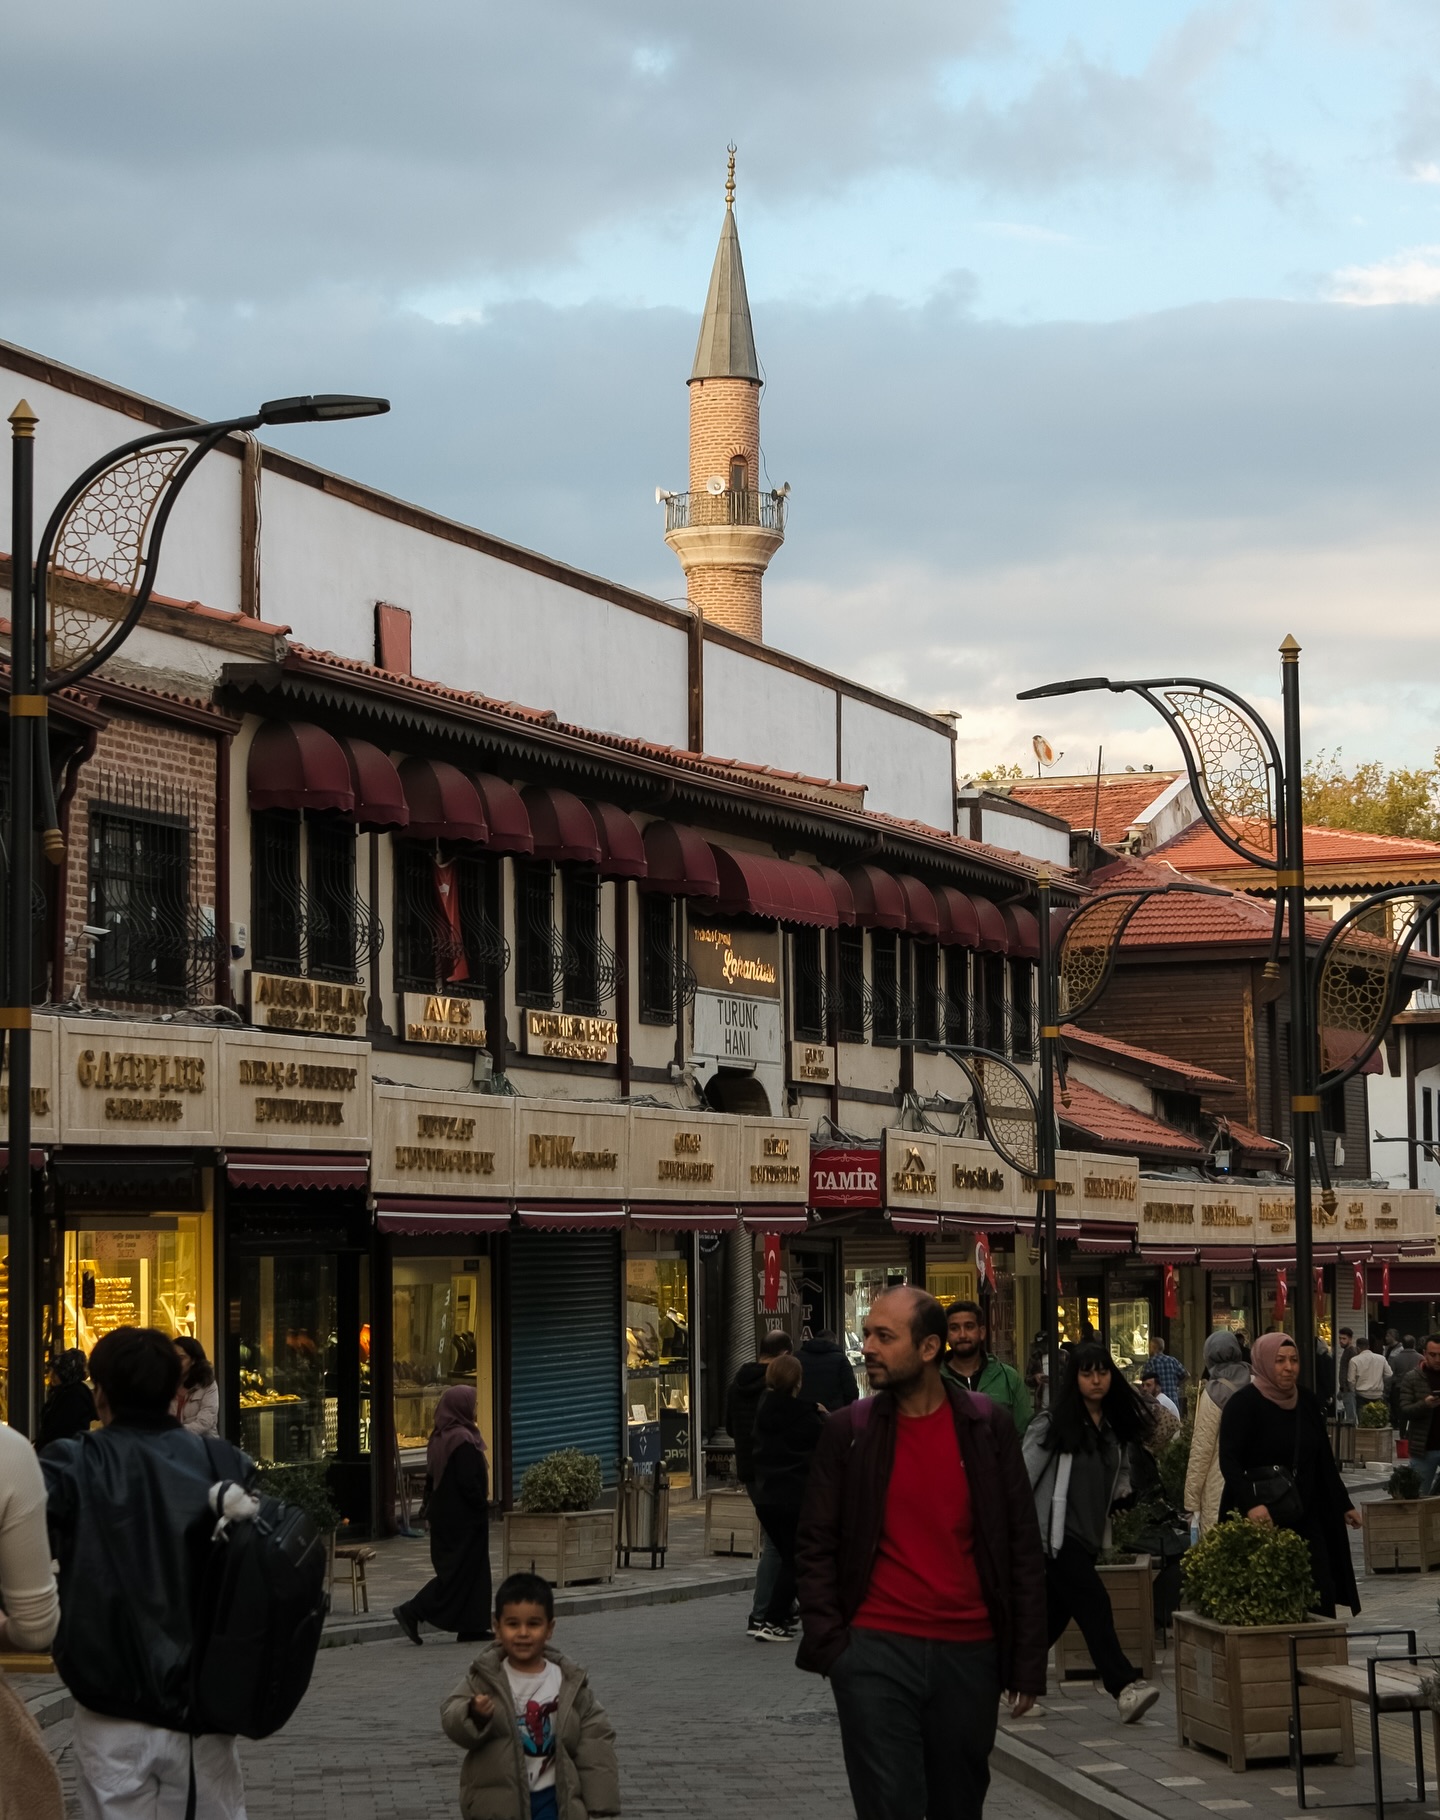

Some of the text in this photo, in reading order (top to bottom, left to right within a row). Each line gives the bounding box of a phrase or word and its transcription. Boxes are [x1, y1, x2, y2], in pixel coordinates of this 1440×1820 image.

[424, 997, 472, 1025] AVES
[717, 998, 759, 1031] TURUNÇ
[724, 1029, 752, 1056] HANI
[813, 1166, 879, 1191] TAMİR
